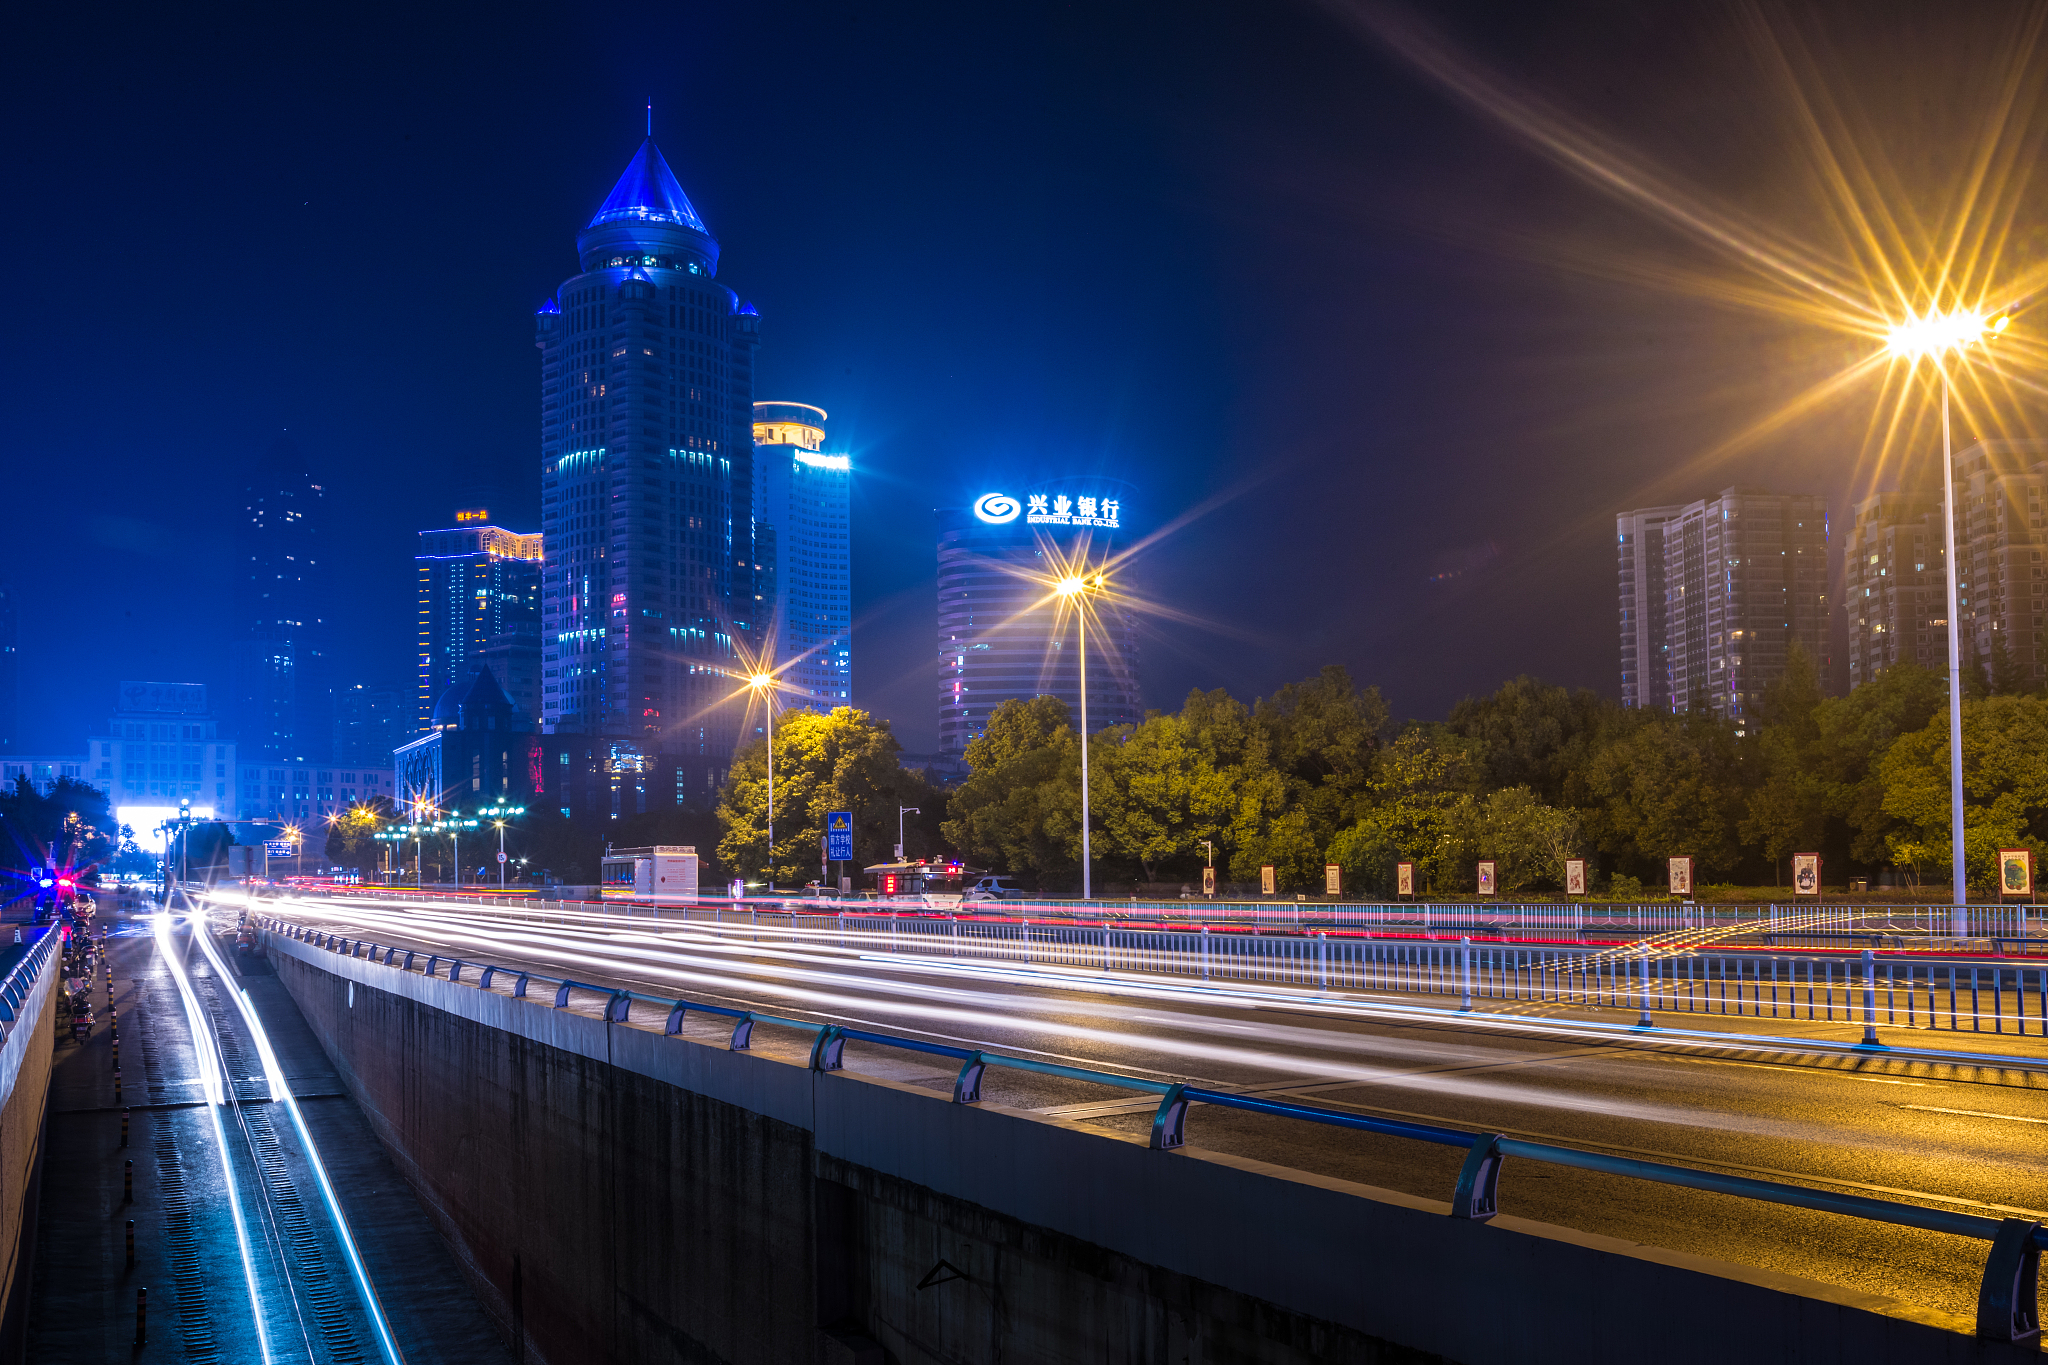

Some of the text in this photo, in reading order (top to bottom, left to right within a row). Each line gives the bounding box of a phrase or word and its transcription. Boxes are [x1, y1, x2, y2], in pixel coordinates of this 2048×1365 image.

[1027, 494, 1120, 519] 兴业银行
[1027, 516, 1070, 525] INDUSTRIAL
[1072, 518, 1092, 526] BANK
[151, 687, 203, 703] 中国电信
[830, 834, 851, 845] 前方学校
[830, 846, 851, 857] 礼让行人
